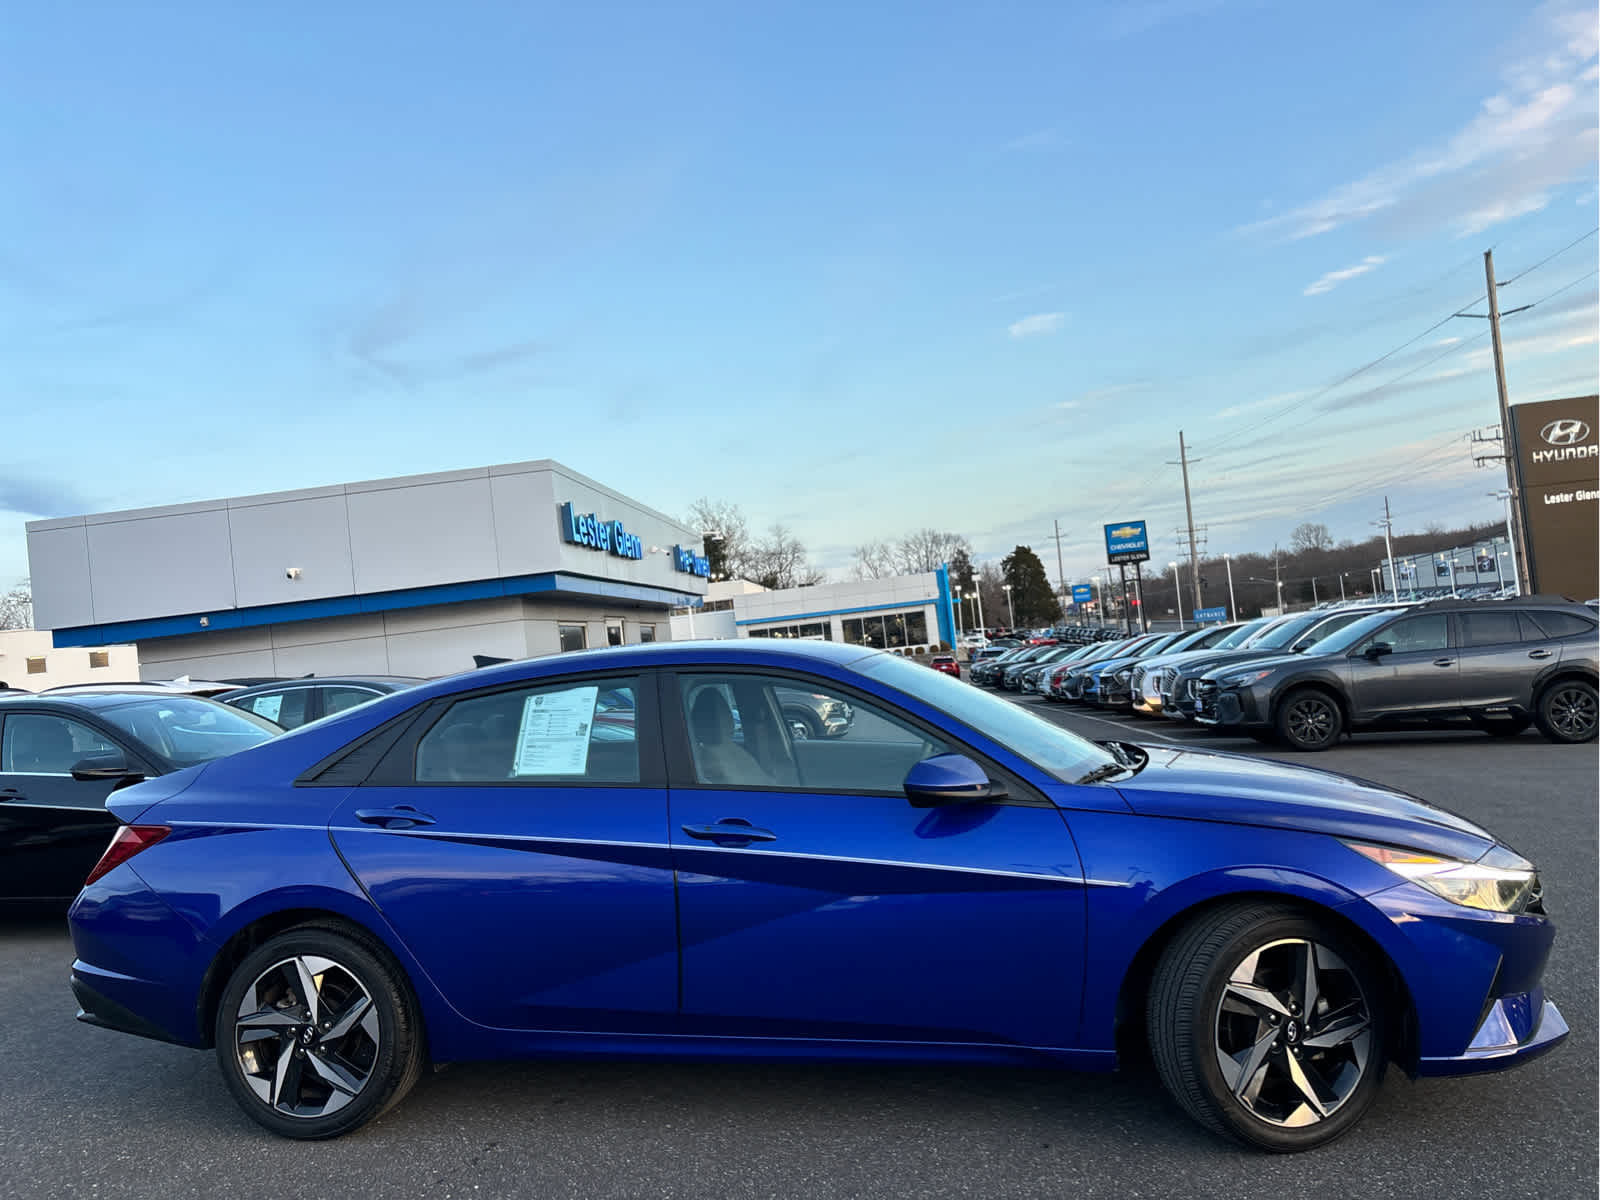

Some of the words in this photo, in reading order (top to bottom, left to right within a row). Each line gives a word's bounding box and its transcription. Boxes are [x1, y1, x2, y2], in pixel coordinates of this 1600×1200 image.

[1544, 493, 1574, 504] Lester
[568, 501, 611, 551] Lester
[614, 519, 643, 560] Glenn
[1110, 541, 1145, 550] CHEVROLET
